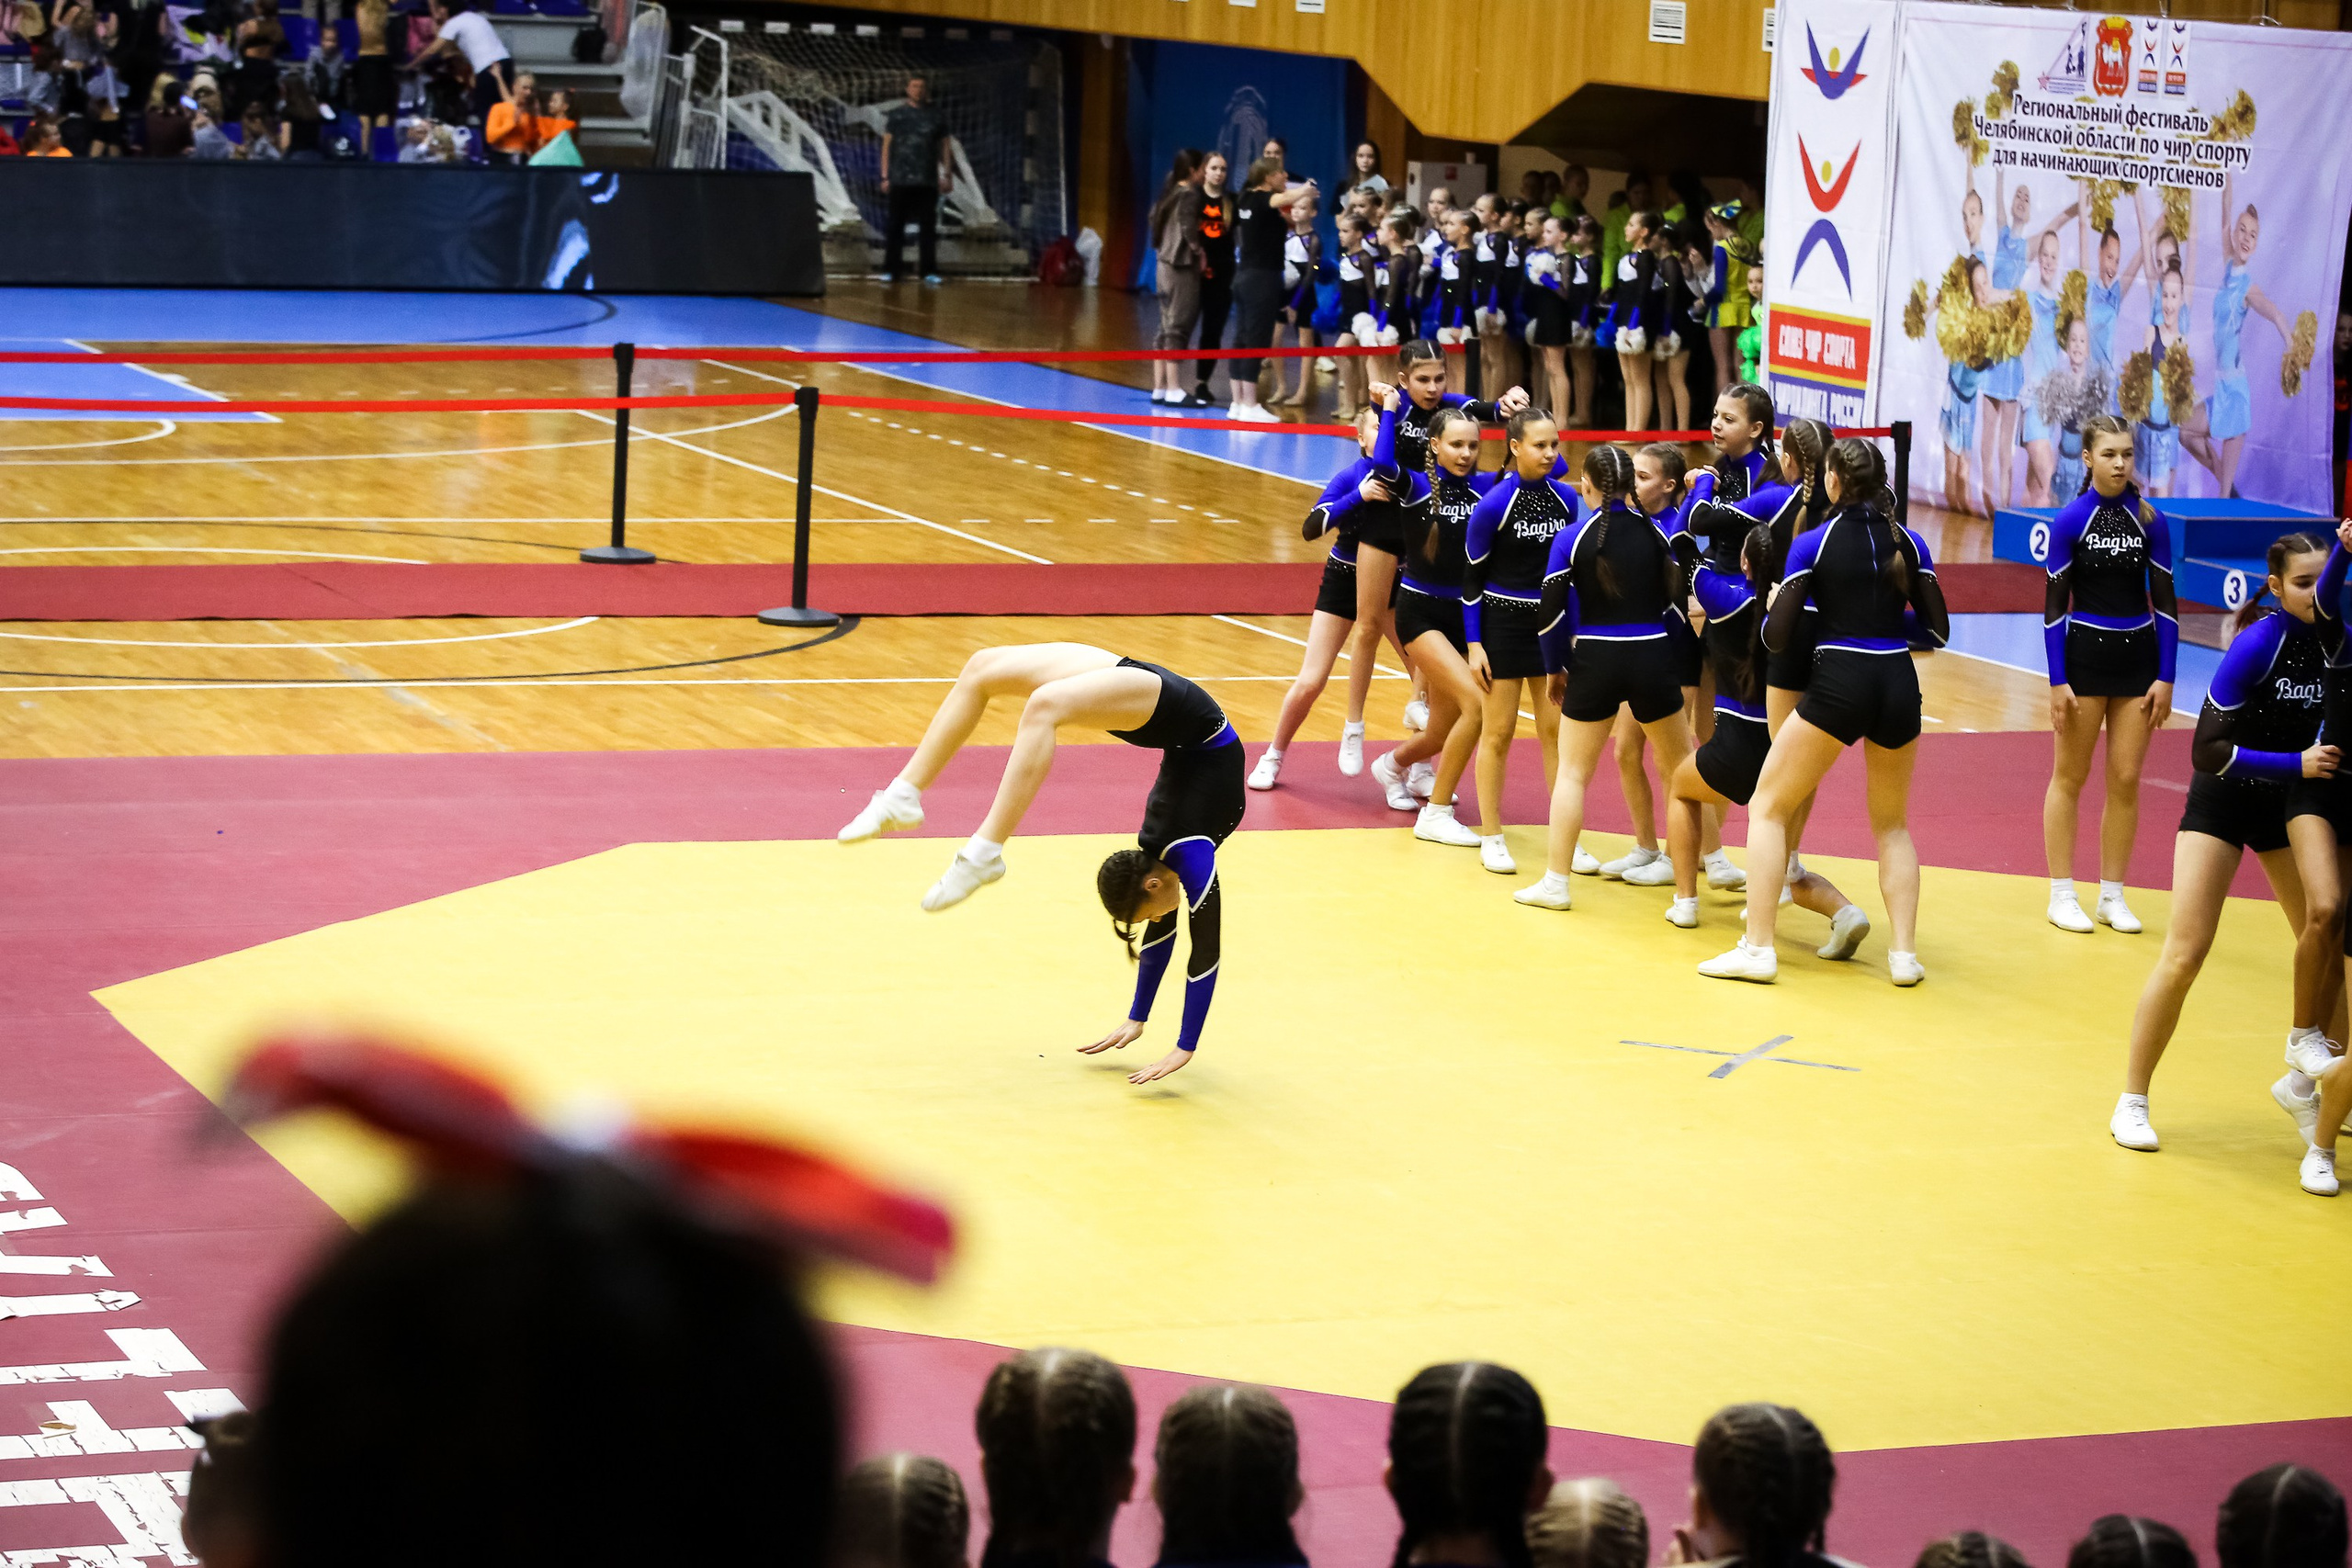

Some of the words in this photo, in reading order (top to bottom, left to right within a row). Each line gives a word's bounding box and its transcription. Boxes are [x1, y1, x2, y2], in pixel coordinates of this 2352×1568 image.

[2013, 94, 2122, 125] Региональный
[2126, 104, 2209, 132] фестиваль
[1974, 115, 2073, 145] Челябинской
[2076, 129, 2135, 152] области
[2140, 138, 2159, 154] по
[2164, 141, 2192, 164] чир
[2196, 142, 2251, 169] спорту
[1993, 148, 2017, 166] для
[2020, 151, 2120, 178] начинающих
[2122, 160, 2224, 188] спортсменов
[1399, 421, 1429, 441] Bag
[2034, 529, 2046, 556] 2
[2086, 533, 2143, 556] Bagira
[2228, 577, 2241, 604] 3
[2275, 678, 2324, 709] Bagi
